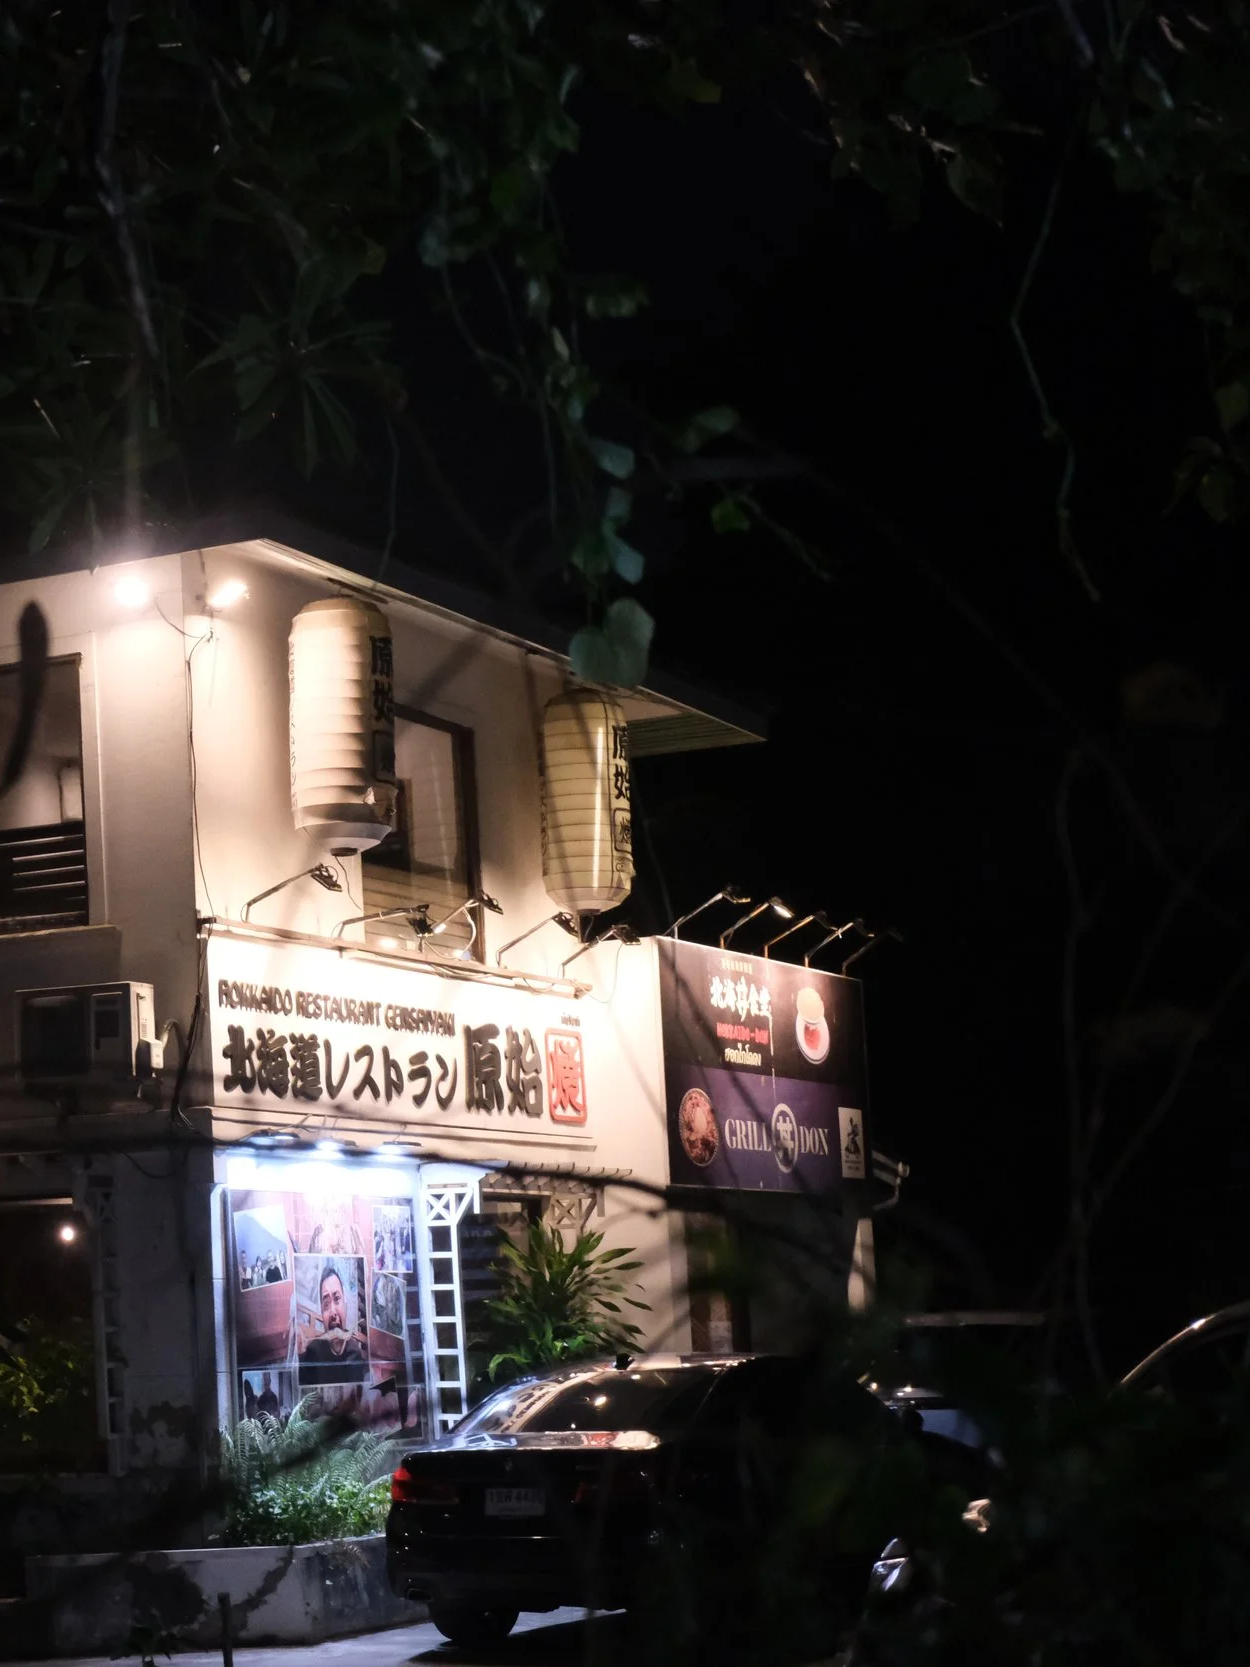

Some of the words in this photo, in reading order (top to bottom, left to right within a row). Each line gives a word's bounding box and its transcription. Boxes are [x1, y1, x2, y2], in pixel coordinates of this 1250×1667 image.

[296, 990, 381, 1027] RESTAURANT
[724, 1118, 772, 1152] GRILL
[799, 1125, 829, 1156] DON
